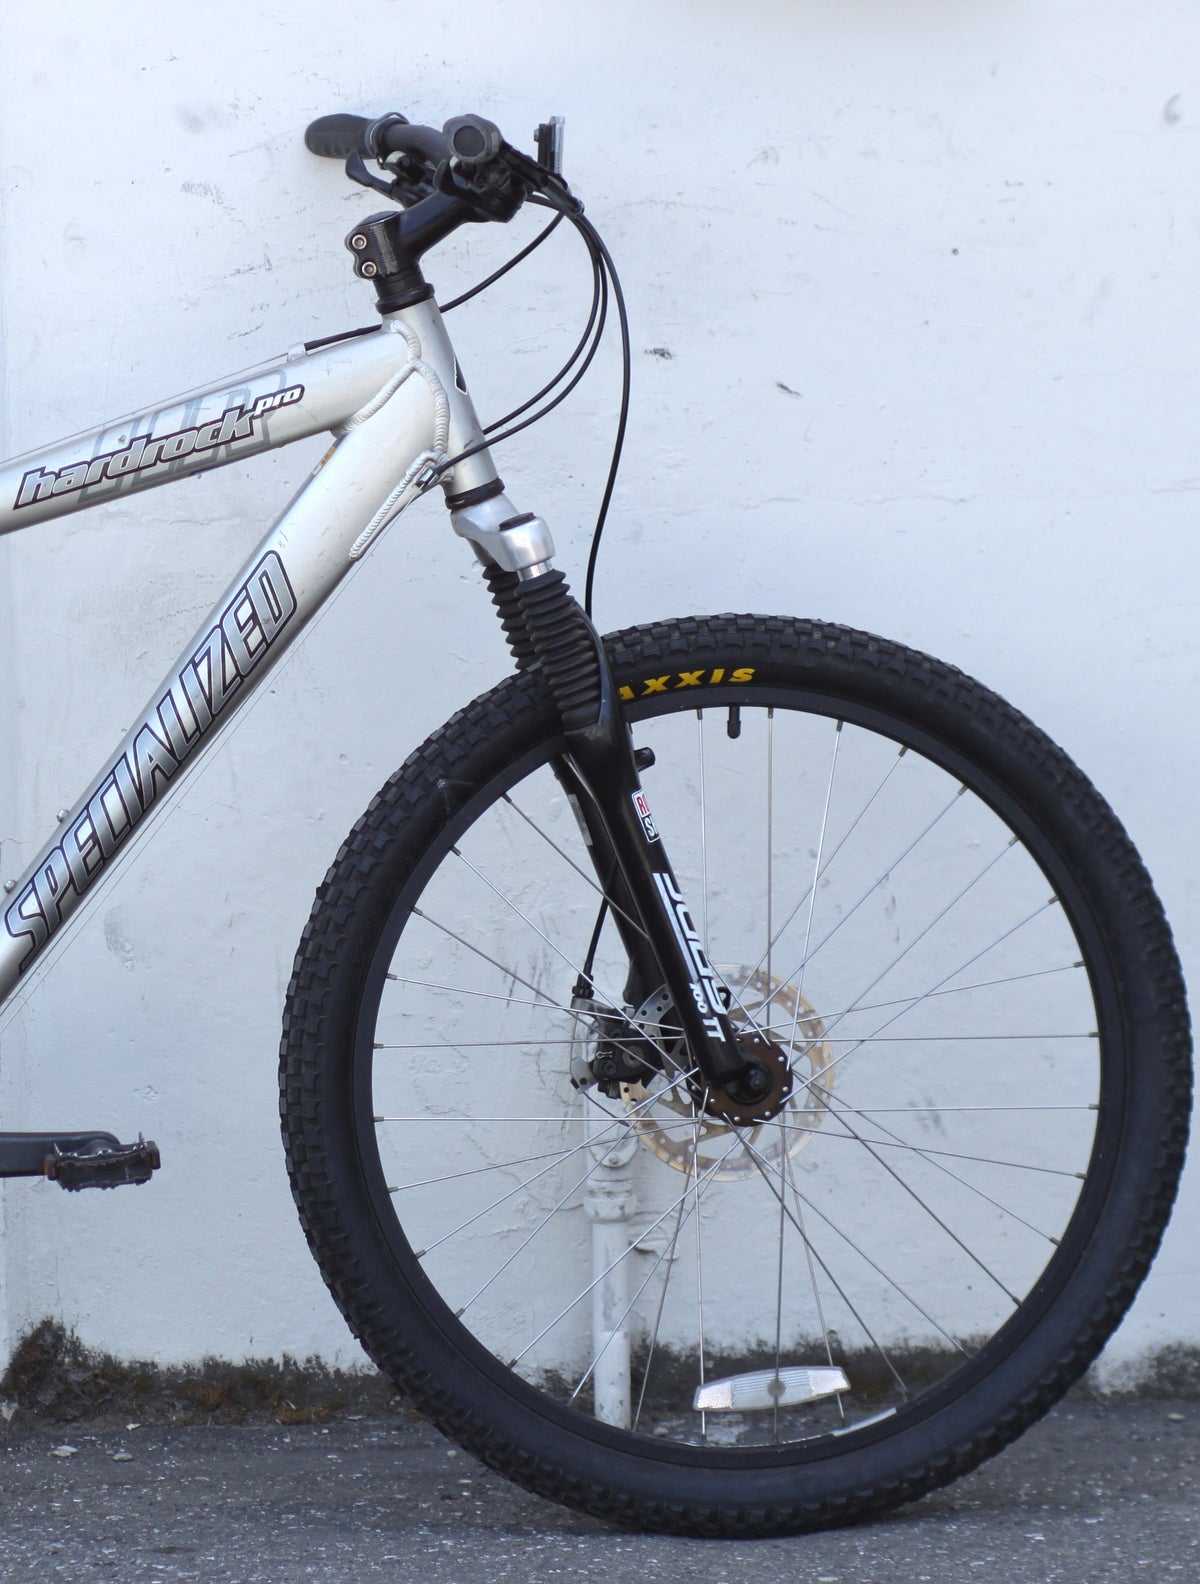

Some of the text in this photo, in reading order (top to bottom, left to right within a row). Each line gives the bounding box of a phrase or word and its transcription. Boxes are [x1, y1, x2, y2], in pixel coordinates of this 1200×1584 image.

[12, 384, 306, 511] hardrock pro
[618, 667, 756, 701] AXXIS
[4, 549, 298, 976] SPECIALIZED
[688, 982, 727, 1042] 100 TT
